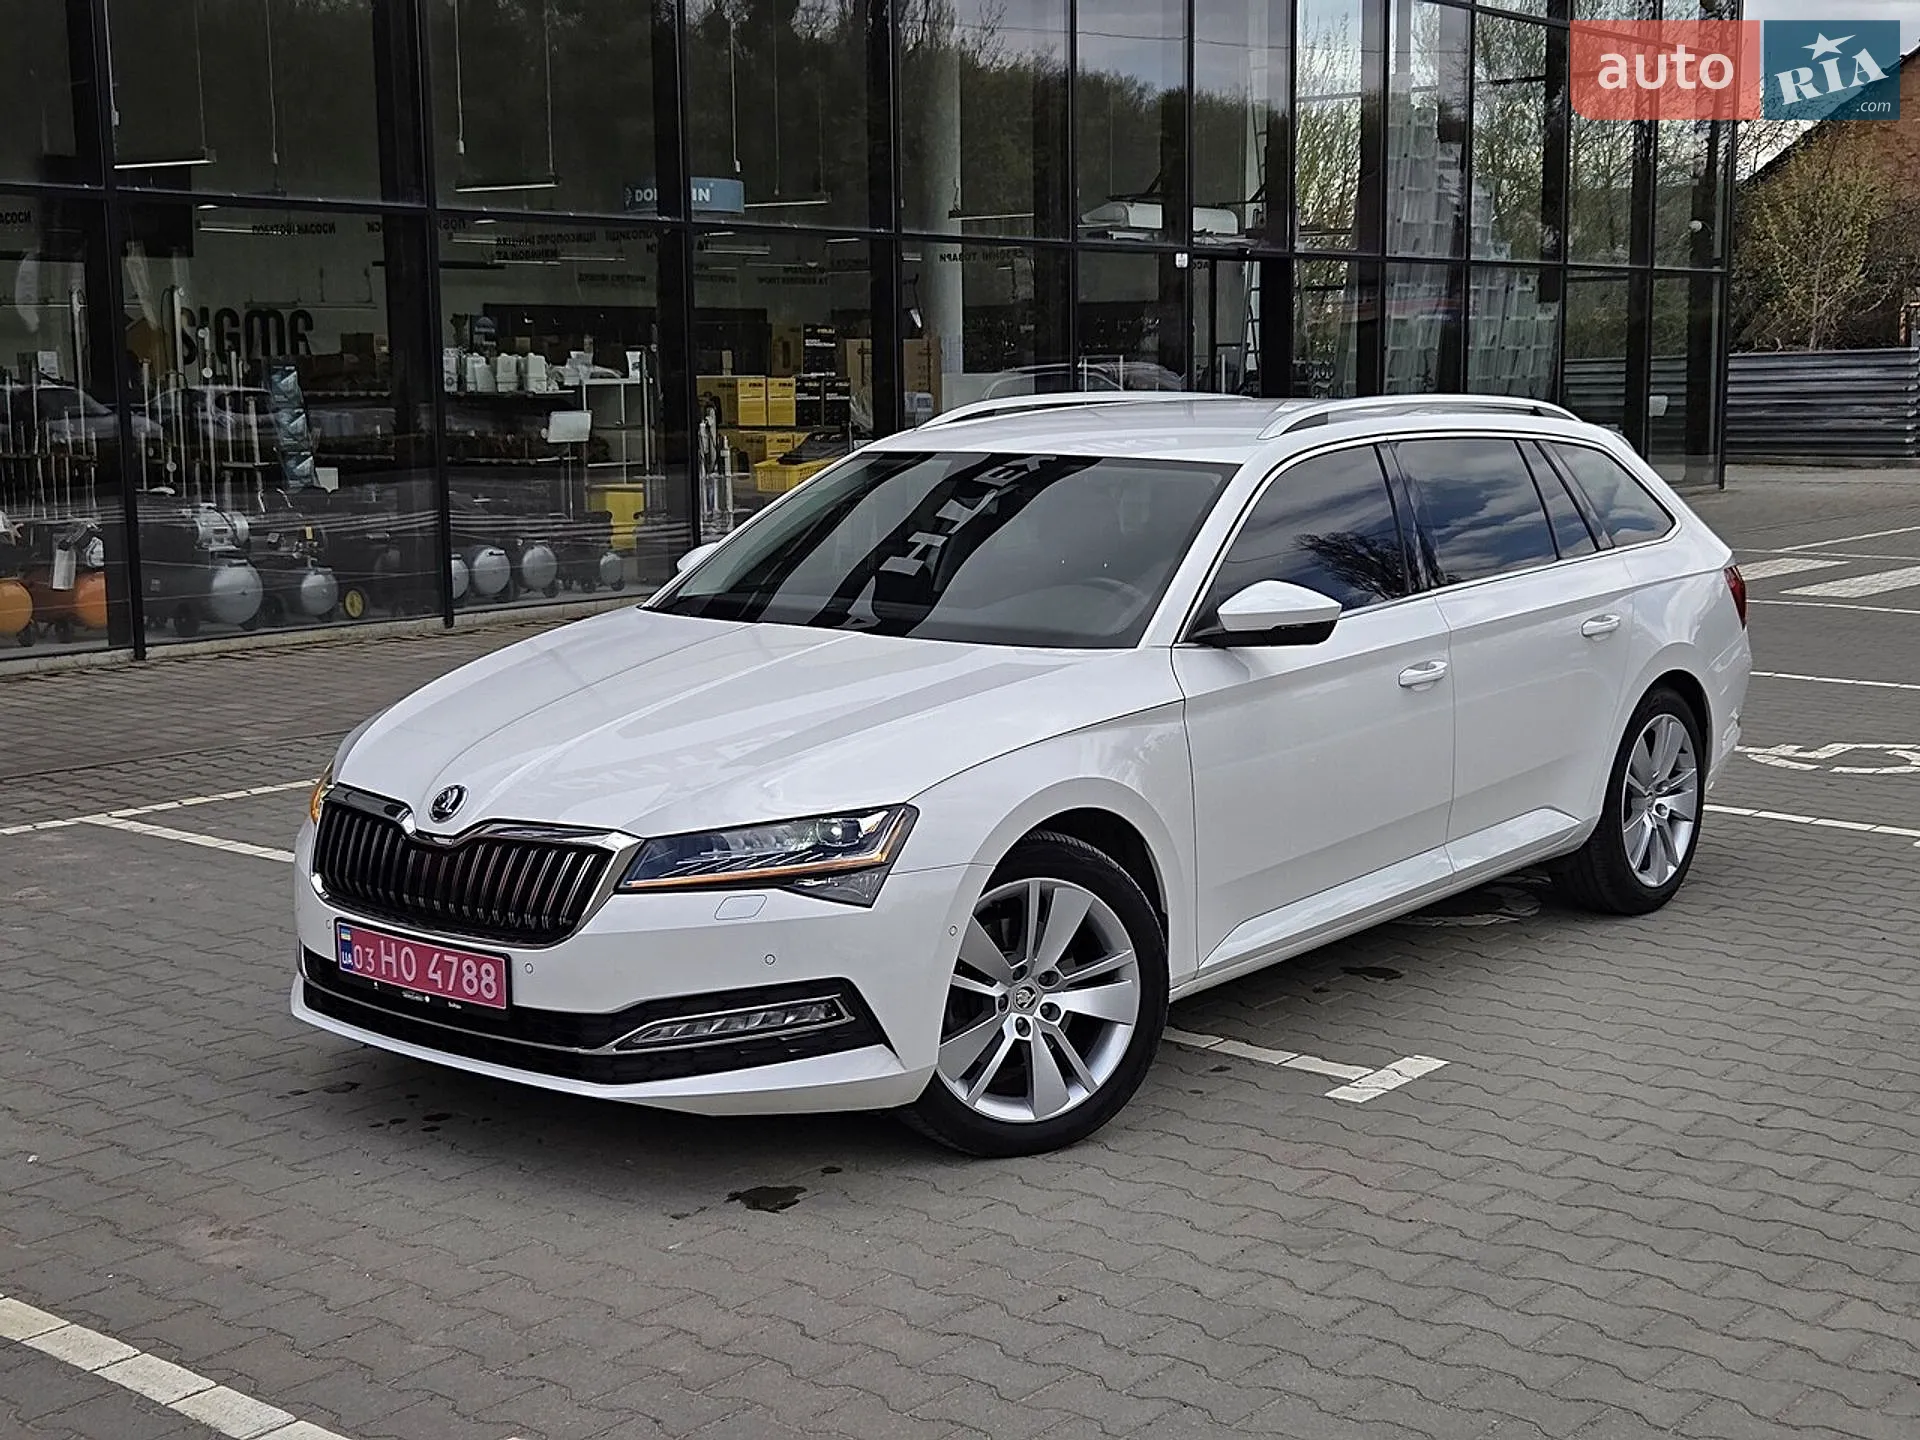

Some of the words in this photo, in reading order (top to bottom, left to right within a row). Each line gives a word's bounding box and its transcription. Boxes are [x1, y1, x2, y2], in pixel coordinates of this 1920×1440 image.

[634, 187, 710, 202] DOIN
[341, 951, 354, 966] UA
[353, 944, 375, 973] 03
[379, 940, 417, 982] HO
[427, 952, 498, 1000] 4788
